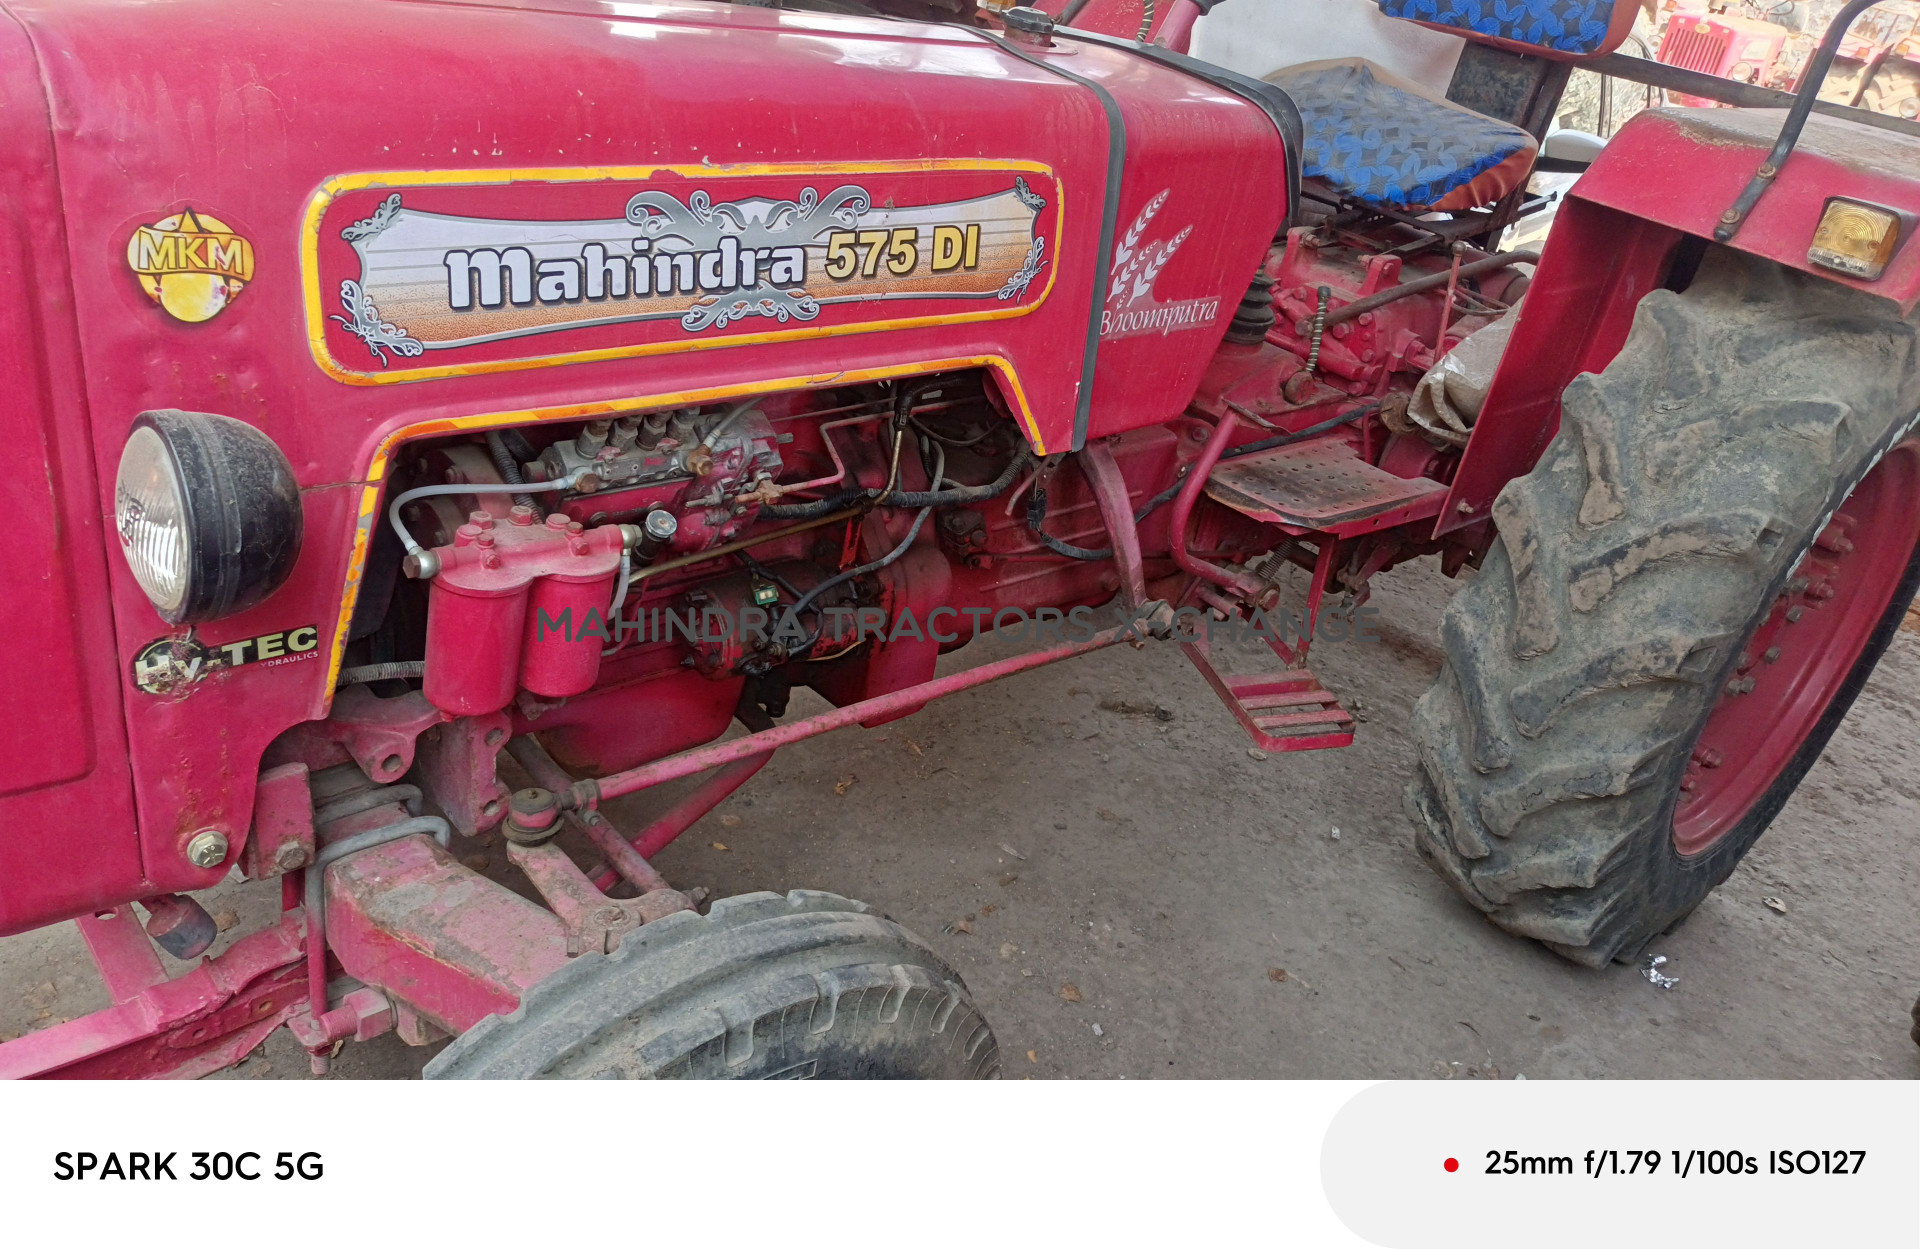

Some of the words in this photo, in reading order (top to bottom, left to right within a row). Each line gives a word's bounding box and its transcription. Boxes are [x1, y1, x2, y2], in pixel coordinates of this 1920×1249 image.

[138, 229, 244, 275] MKM
[443, 235, 804, 309] Mahindra
[825, 228, 918, 279] 575
[931, 224, 981, 271] DI
[1100, 301, 1218, 336] Bhoomiputra
